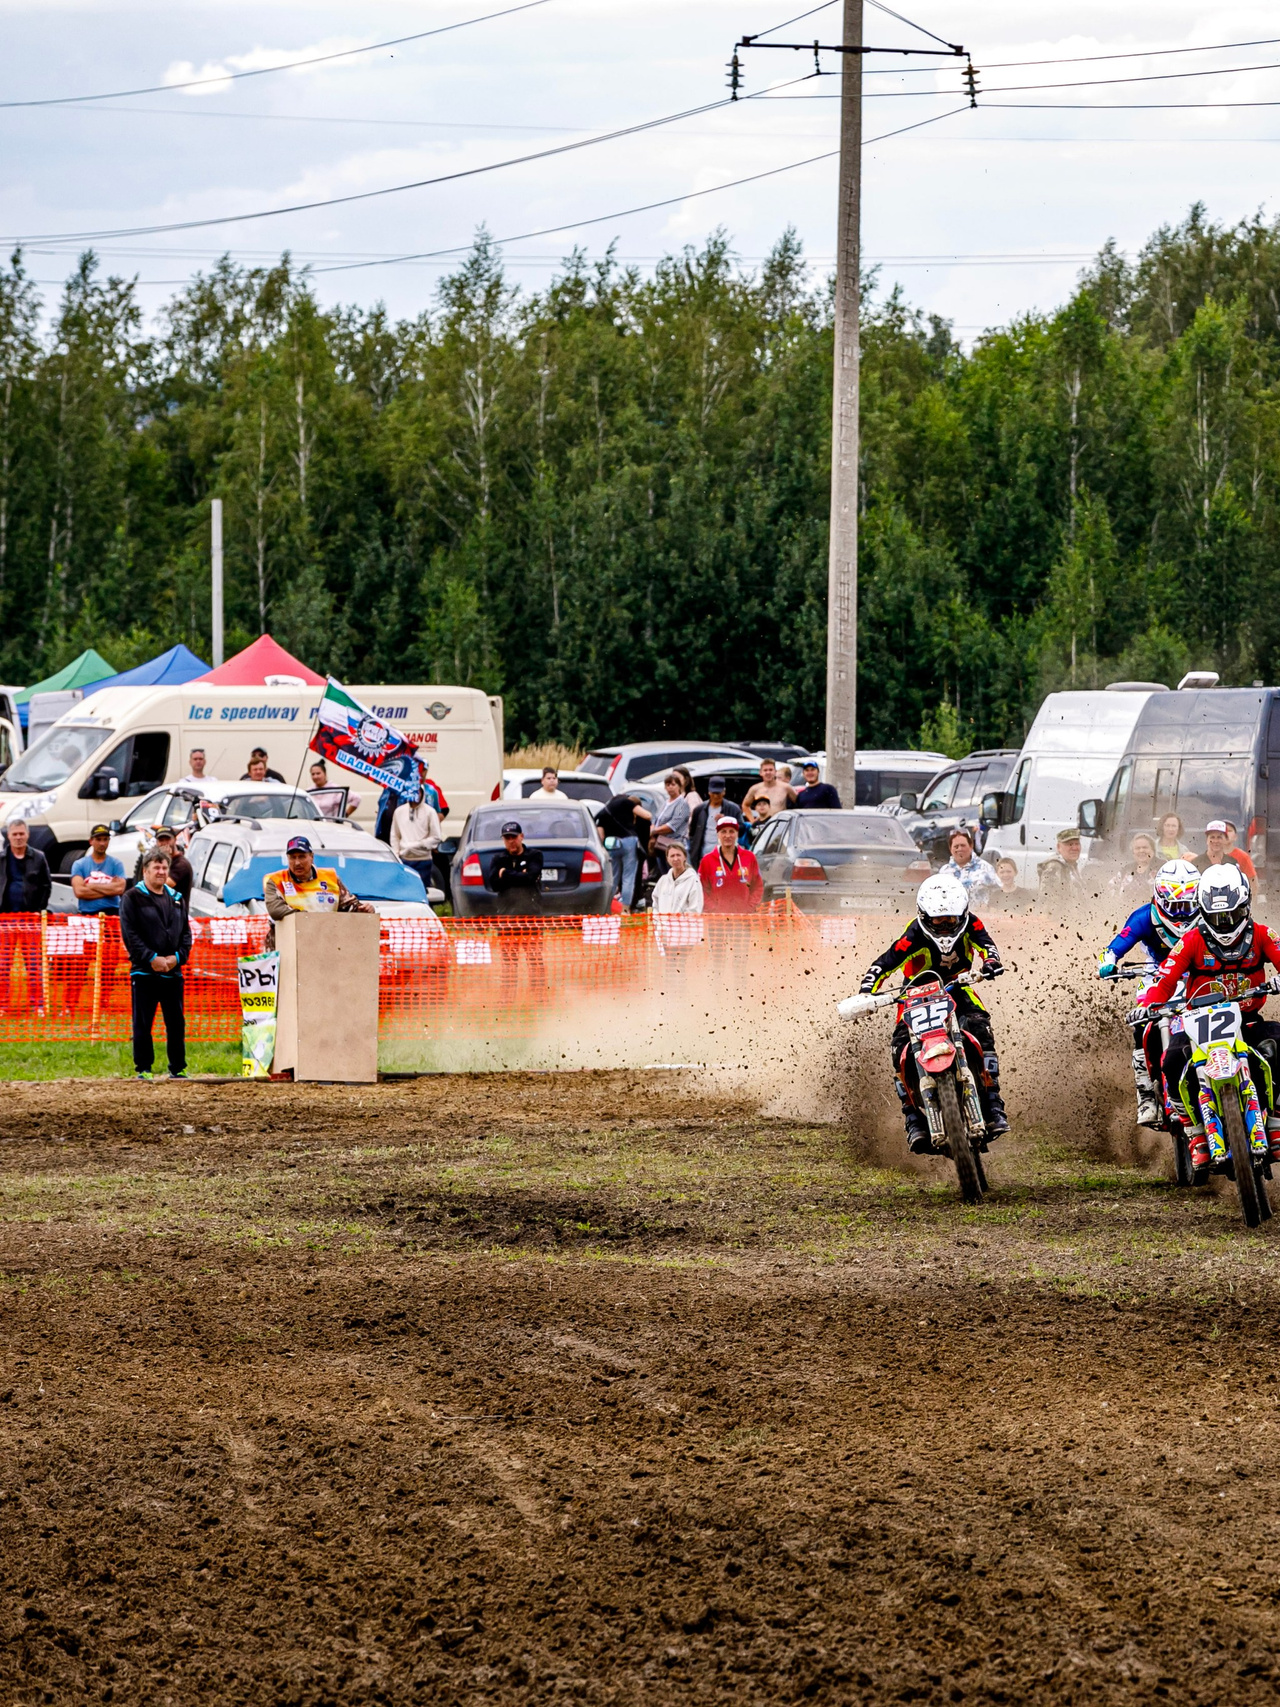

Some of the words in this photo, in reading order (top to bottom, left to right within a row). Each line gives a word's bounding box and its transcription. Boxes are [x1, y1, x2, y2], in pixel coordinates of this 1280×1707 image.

[188, 704, 213, 720] Ice
[220, 704, 299, 722] speedway
[371, 705, 408, 719] team
[337, 750, 404, 791] ШАДРИНСК
[911, 1001, 949, 1034] 25
[1194, 1011, 1236, 1045] 12
[1199, 1093, 1212, 1124] Uktus
[1206, 1122, 1219, 1150] Moto
